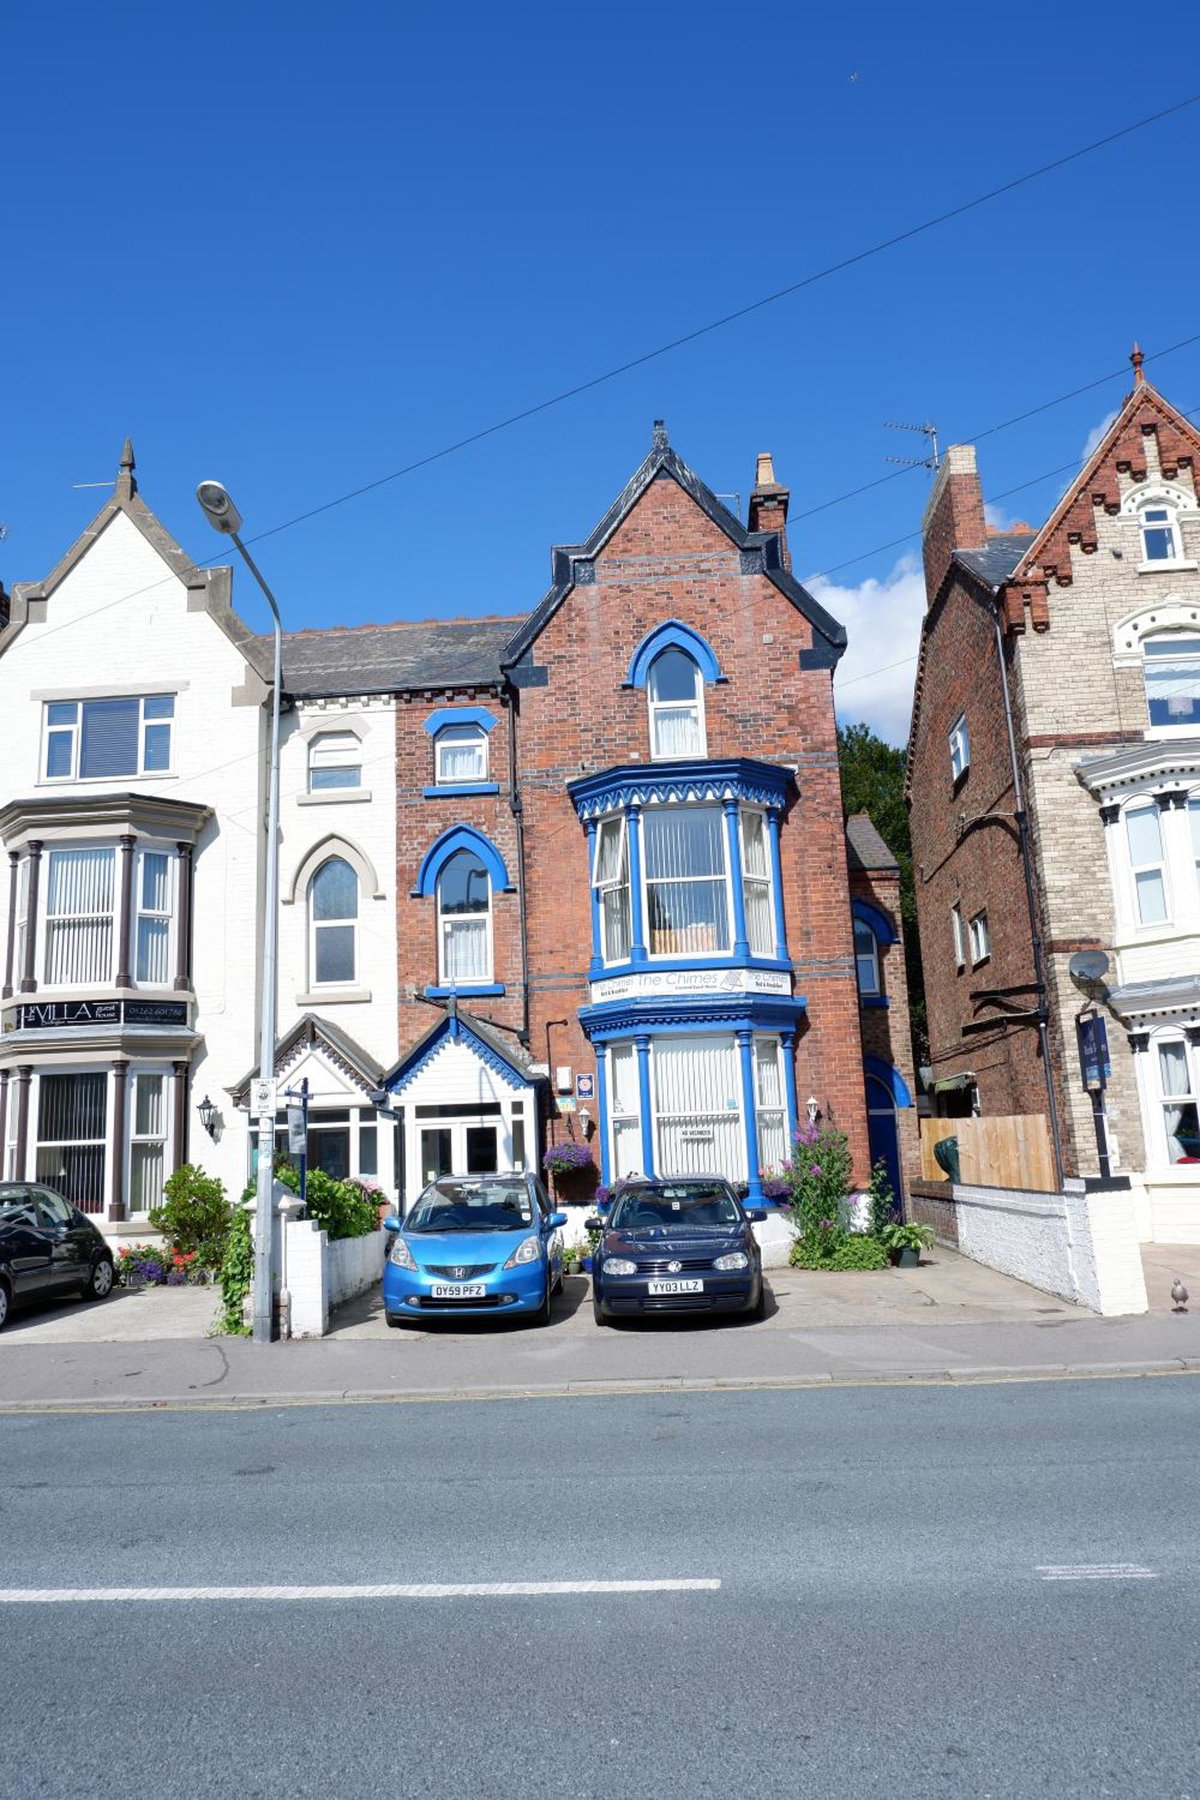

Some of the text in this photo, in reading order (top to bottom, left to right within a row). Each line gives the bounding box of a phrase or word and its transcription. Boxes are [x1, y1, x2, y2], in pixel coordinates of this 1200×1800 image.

[665, 972, 718, 985] Chimes
[35, 1003, 92, 1021] VILLA
[463, 1285, 482, 1296] PFZ
[653, 1281, 699, 1293] YY03 LLZ
